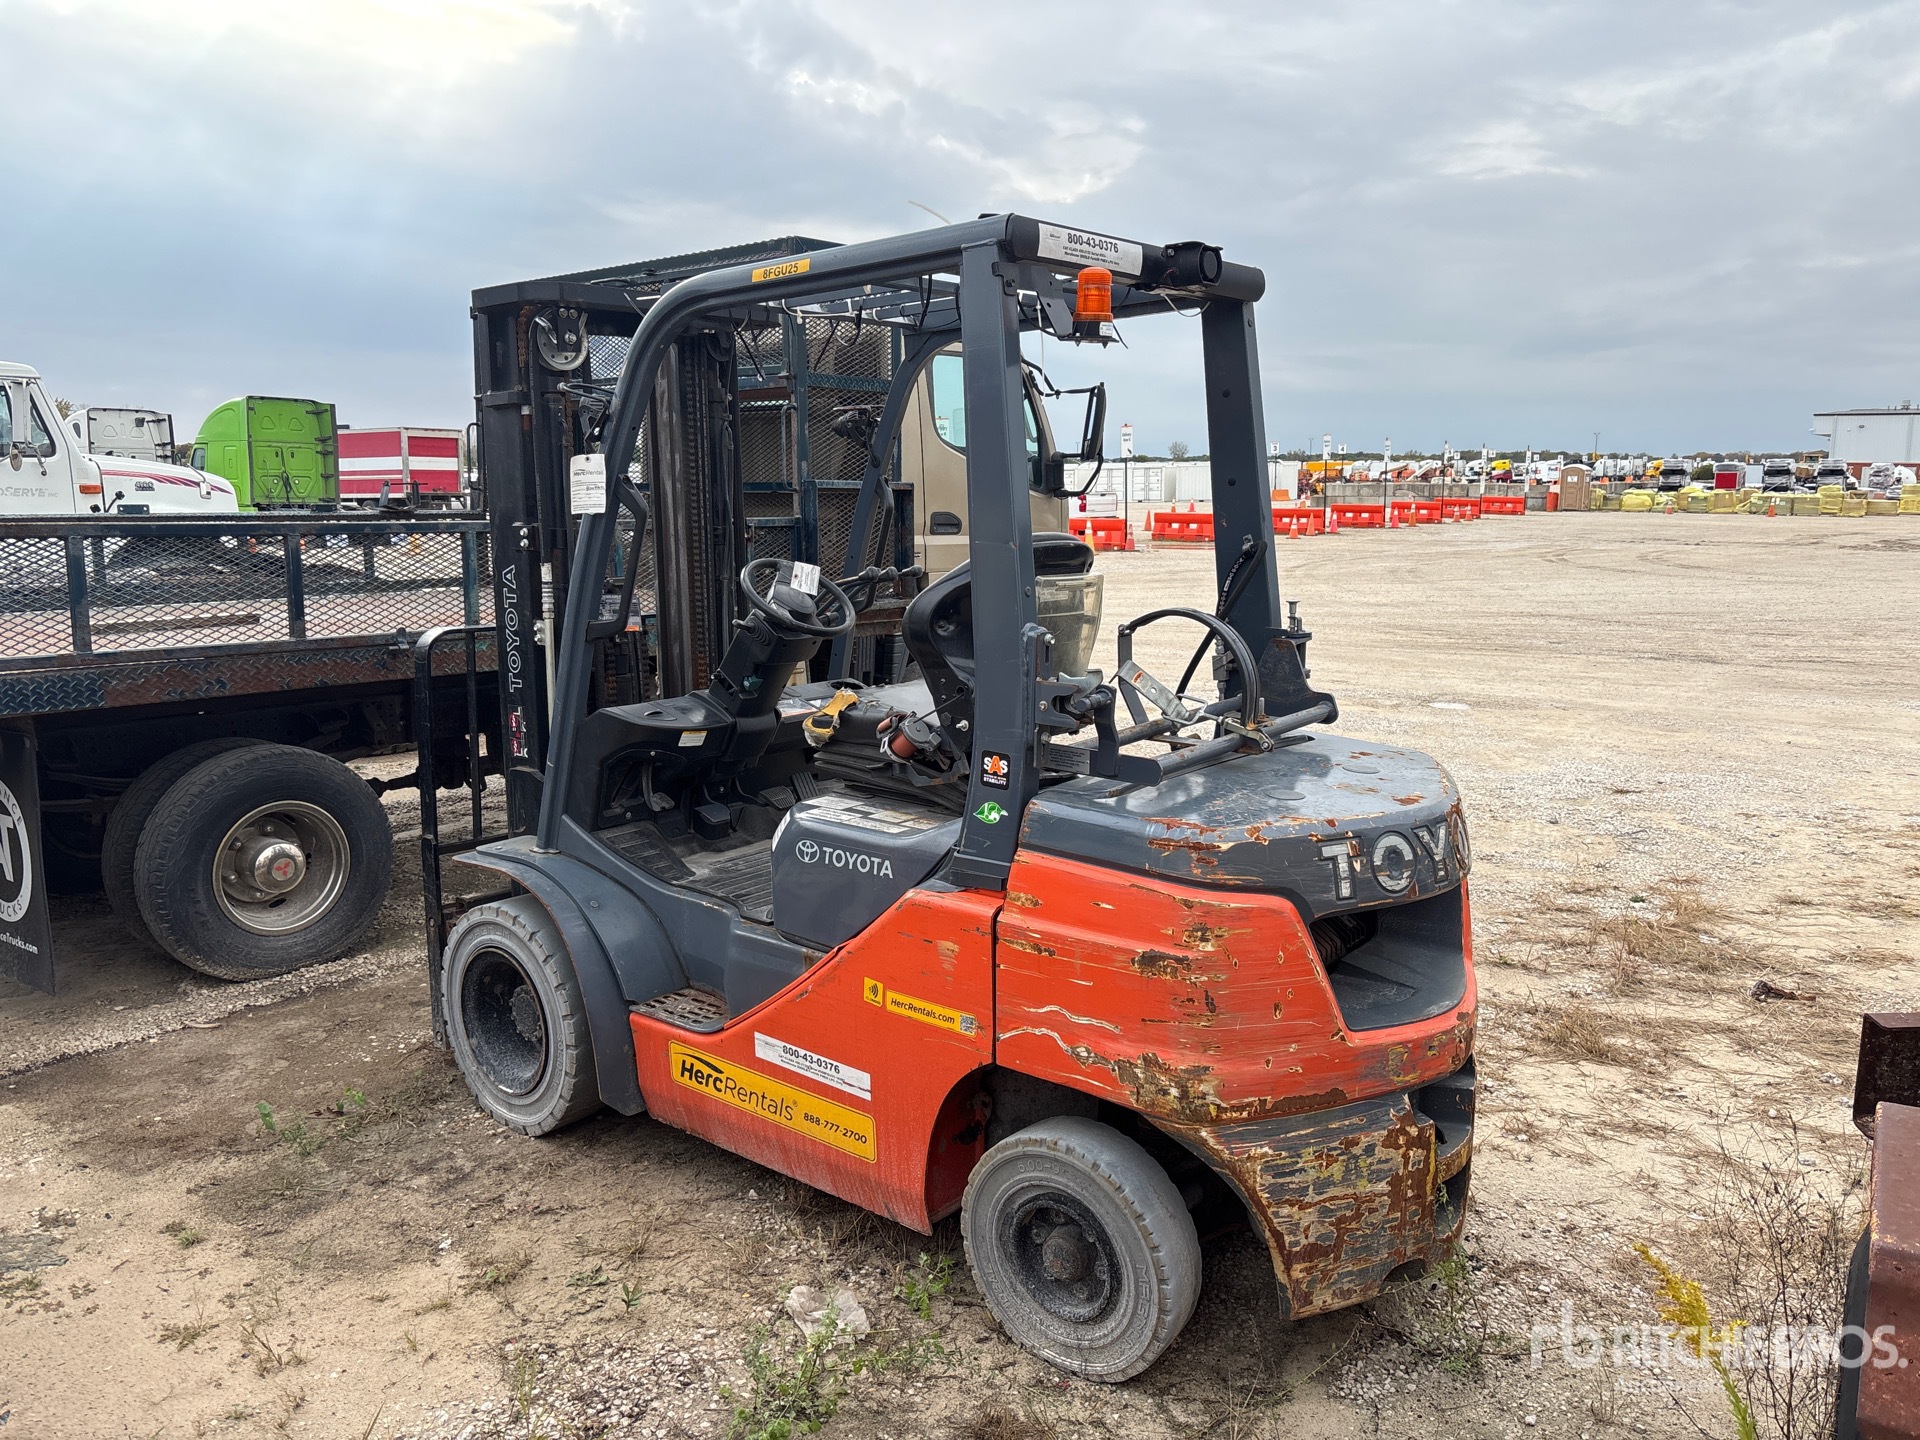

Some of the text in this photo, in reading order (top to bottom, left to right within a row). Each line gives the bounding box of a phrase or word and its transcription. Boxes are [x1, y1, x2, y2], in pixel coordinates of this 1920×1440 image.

[1067, 232, 1119, 254] 800-43-0376
[762, 262, 799, 279] 8FGU25
[502, 564, 523, 693] TOYOTA
[983, 755, 1008, 776] SAS
[822, 846, 894, 879] TOYOTA
[890, 997, 955, 1025] HercRentals.com
[782, 1044, 840, 1075] 800-43-0376
[803, 1111, 868, 1145] 888-777-2700
